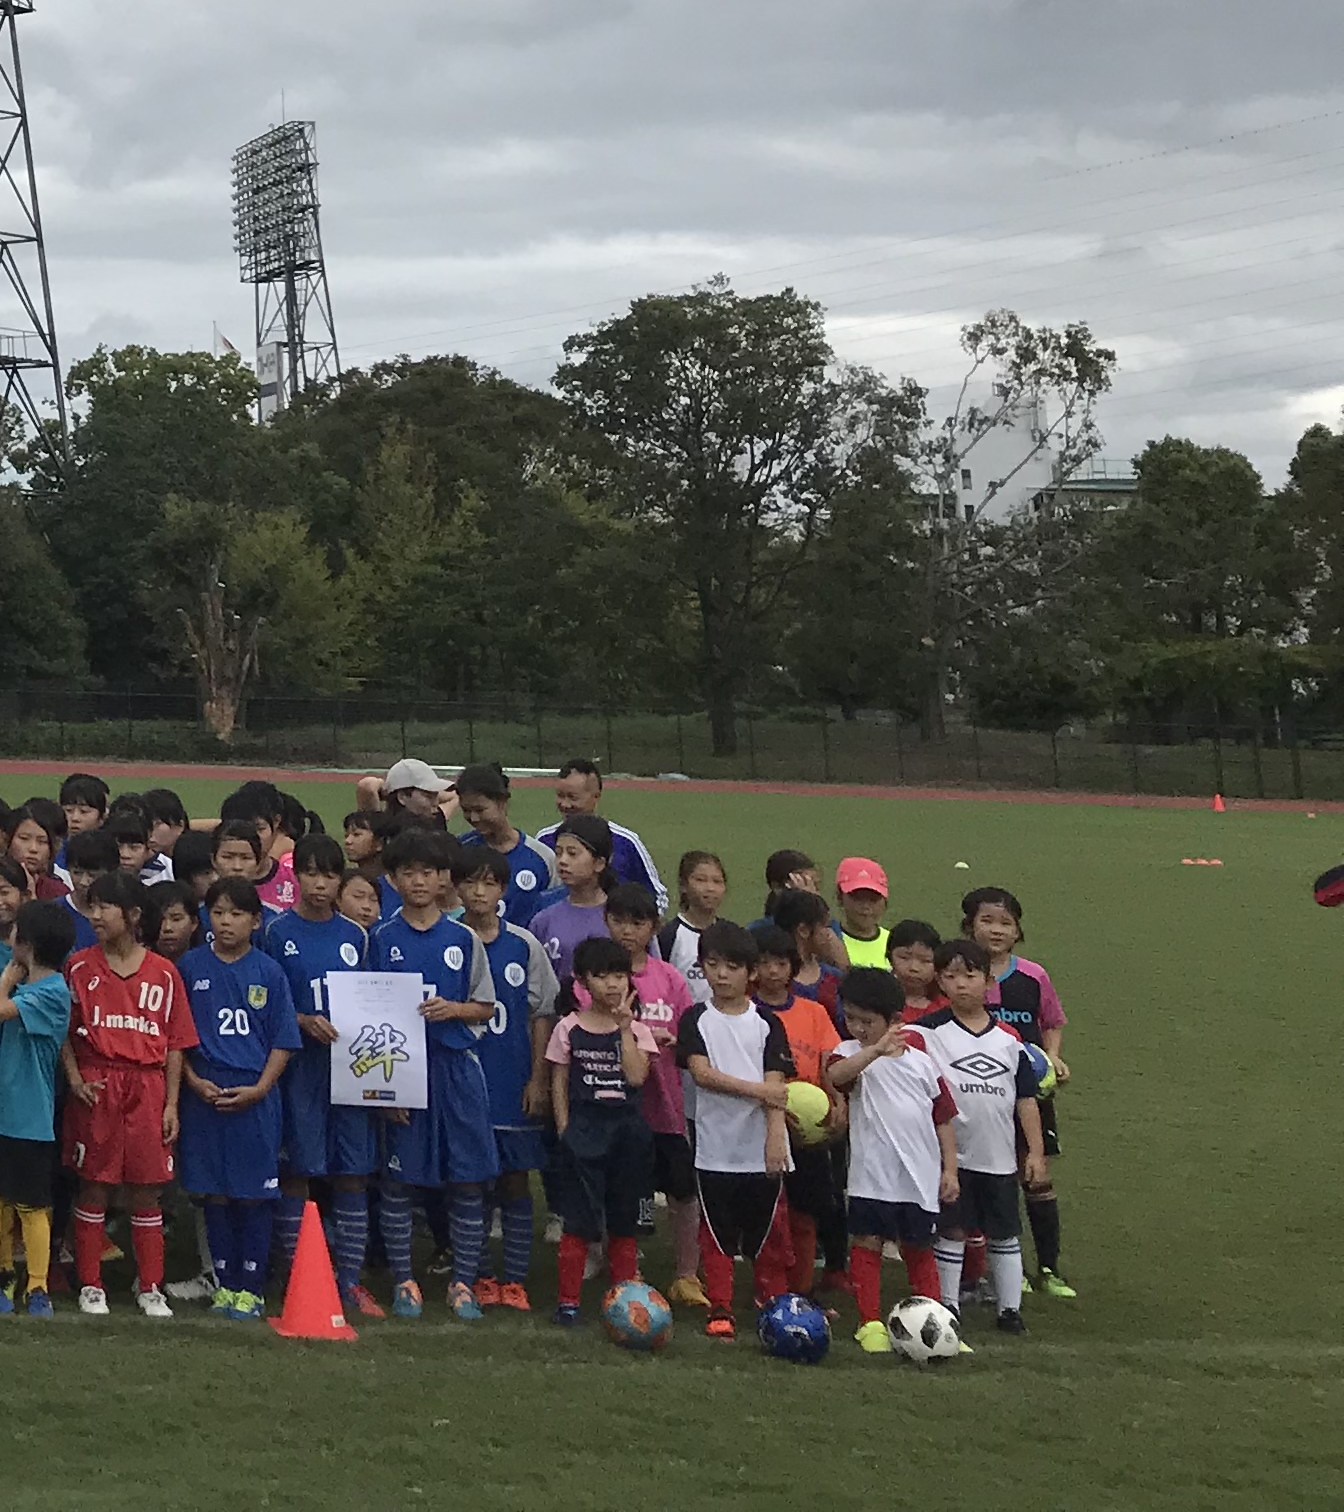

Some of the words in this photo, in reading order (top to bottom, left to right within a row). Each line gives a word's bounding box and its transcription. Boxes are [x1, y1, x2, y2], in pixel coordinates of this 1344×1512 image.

[138, 981, 164, 1012] 10
[92, 1005, 161, 1037] J.marka
[218, 1007, 250, 1036] 20
[987, 1007, 1033, 1024] mbro
[348, 1022, 410, 1083] 絆
[960, 1082, 1006, 1097] umbro
